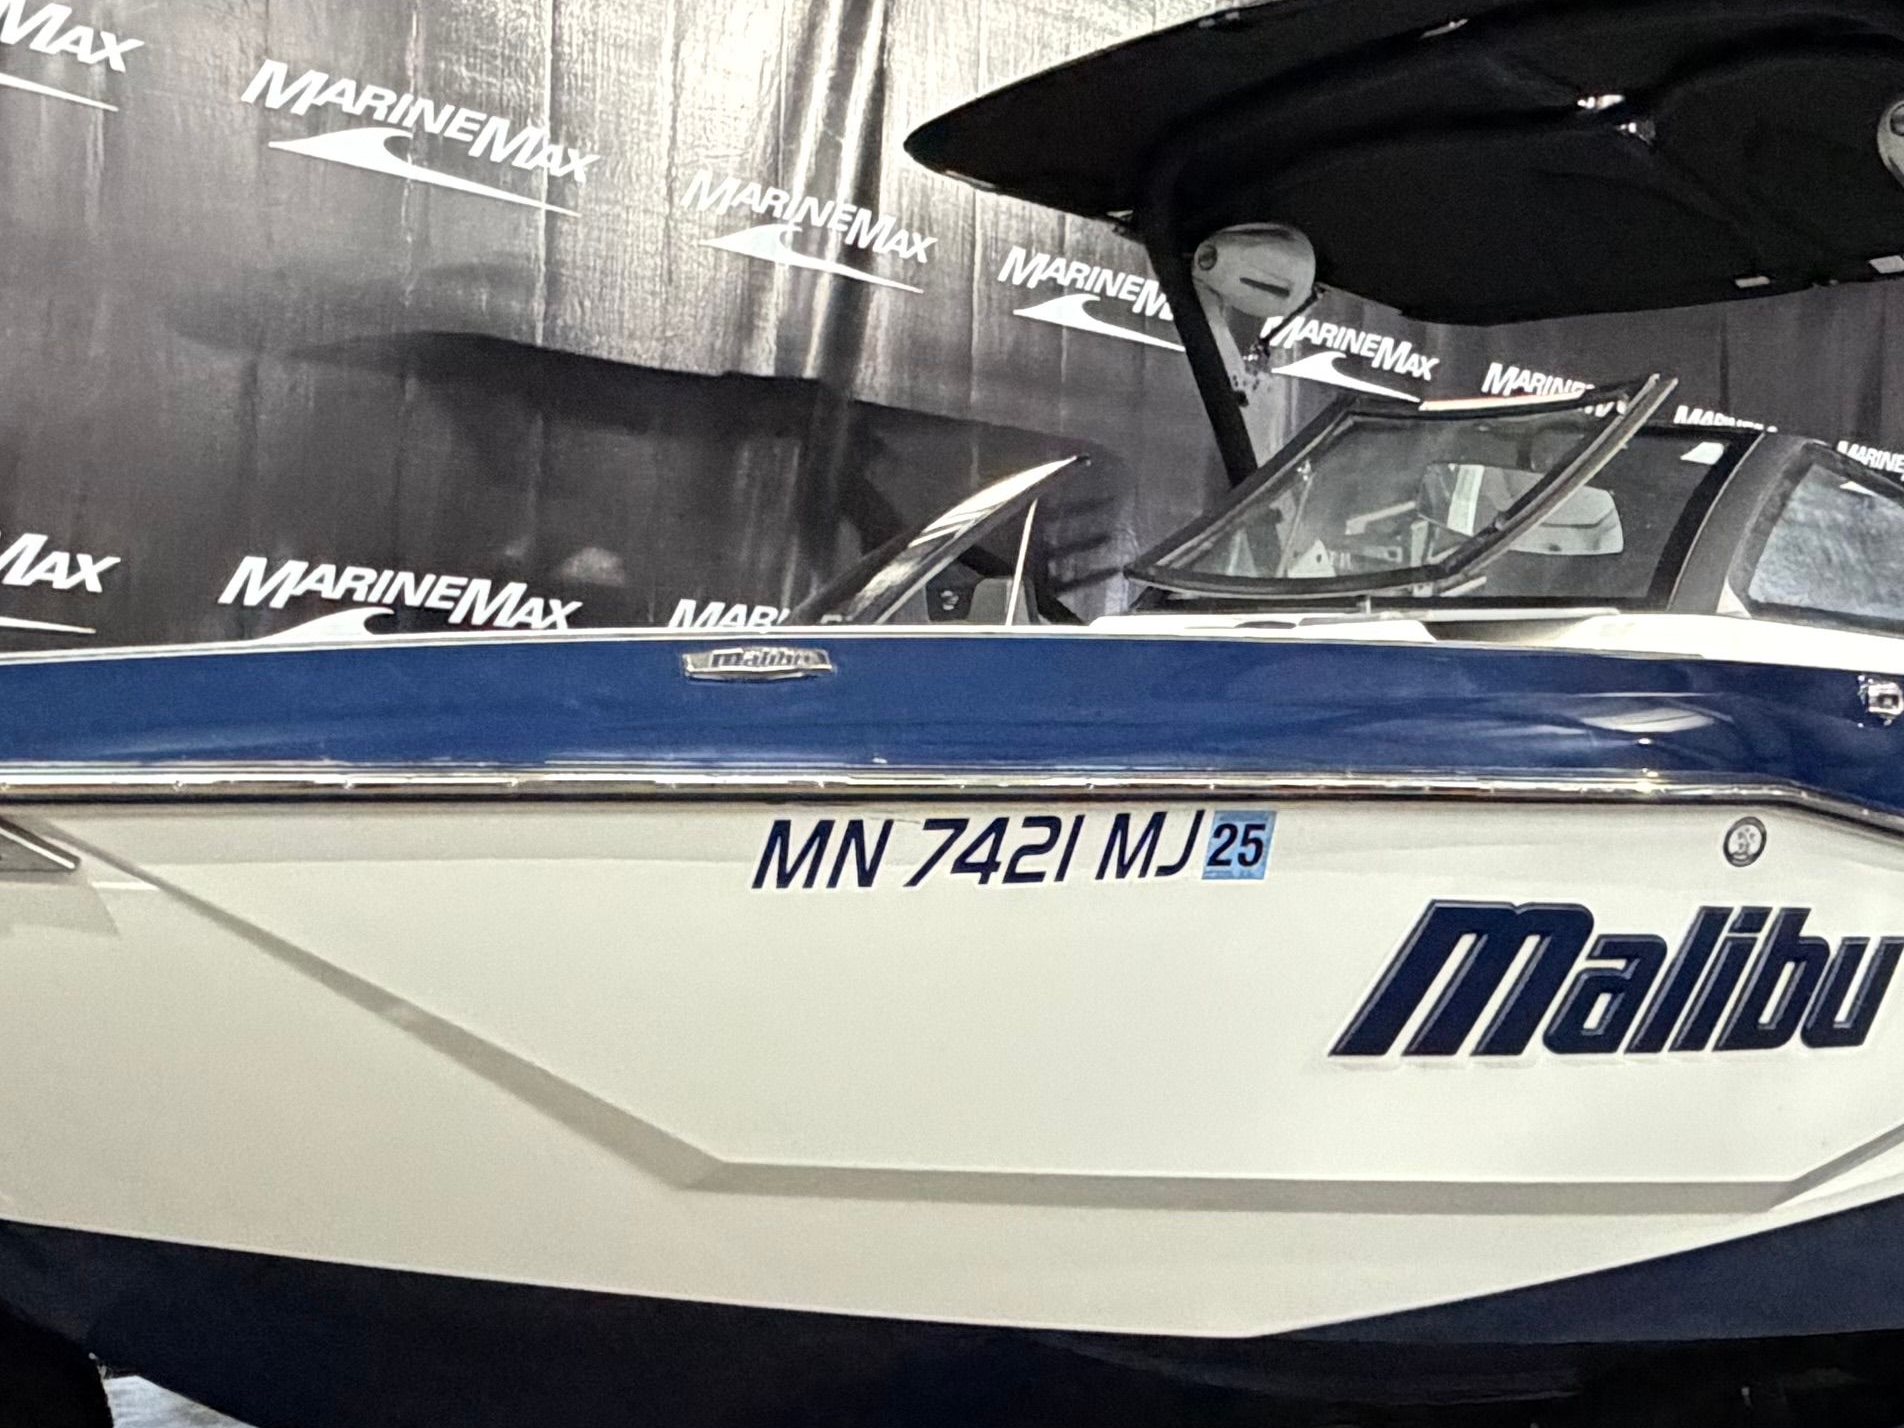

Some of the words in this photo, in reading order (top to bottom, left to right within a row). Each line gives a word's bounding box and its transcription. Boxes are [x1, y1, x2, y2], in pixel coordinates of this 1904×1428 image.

[997, 245, 1174, 321] MARINEM
[751, 818, 894, 889] MN
[903, 814, 1085, 888] 7421
[1095, 809, 1205, 881] MJ
[1207, 823, 1265, 867] 25
